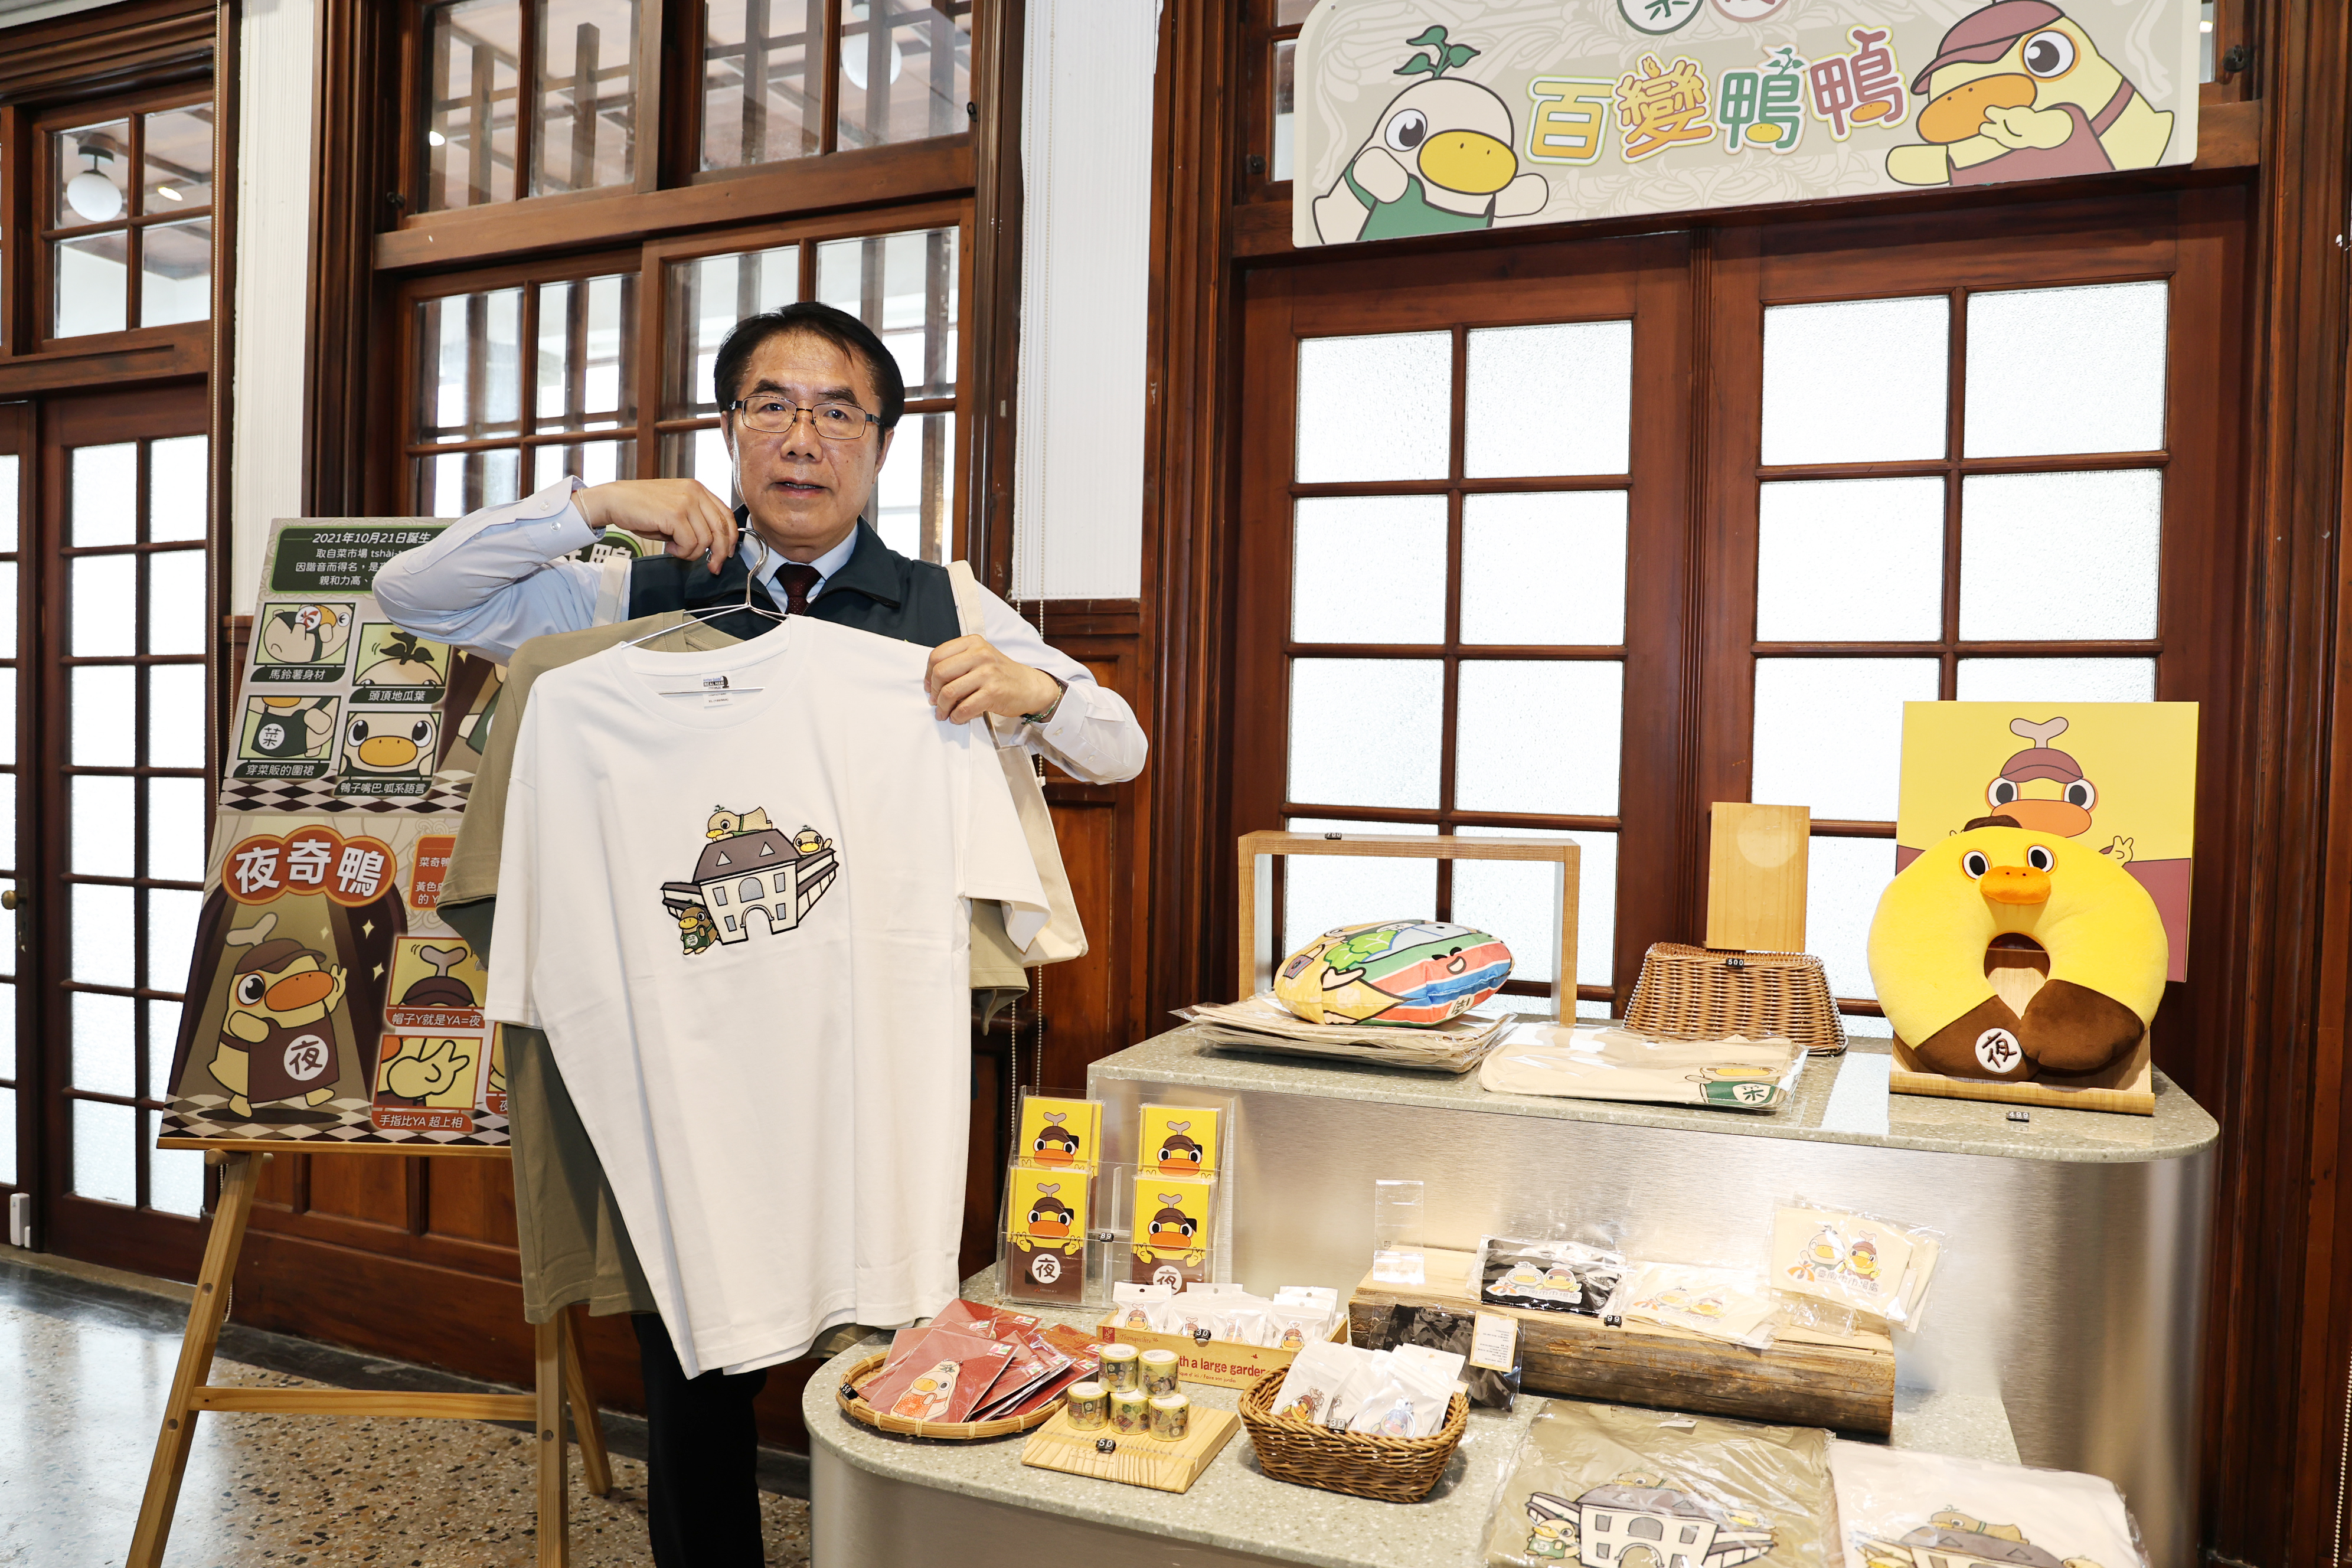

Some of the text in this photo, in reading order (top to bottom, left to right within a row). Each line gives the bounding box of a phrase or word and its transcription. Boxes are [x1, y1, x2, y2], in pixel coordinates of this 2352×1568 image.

[1530, 30, 1903, 158] 百變鴨鴨
[312, 532, 432, 544] 2021年10月21日誕生
[316, 548, 368, 559] 取自菜市場
[269, 669, 326, 680] 馬鈴薯身材
[368, 690, 426, 701] 頭頂地瓜葉
[262, 727, 282, 747] 菜
[246, 764, 315, 776] 穿菜販的圍裙
[235, 839, 385, 897] 夜奇鴨
[418, 894, 429, 904] 的
[391, 1013, 483, 1027] 帽子Y就是YA=夜
[1982, 1031, 2017, 1069] 夜
[289, 1040, 323, 1075] 夜
[379, 1114, 463, 1128] 手指比YA 超上相
[1035, 1257, 1056, 1278] 夜
[1607, 1315, 1620, 1323] 99
[1180, 1355, 1189, 1367] th
[1191, 1359, 1197, 1368] a
[1200, 1358, 1227, 1373] large
[1330, 1419, 1344, 1428] 30
[1099, 1439, 1113, 1448] 50
